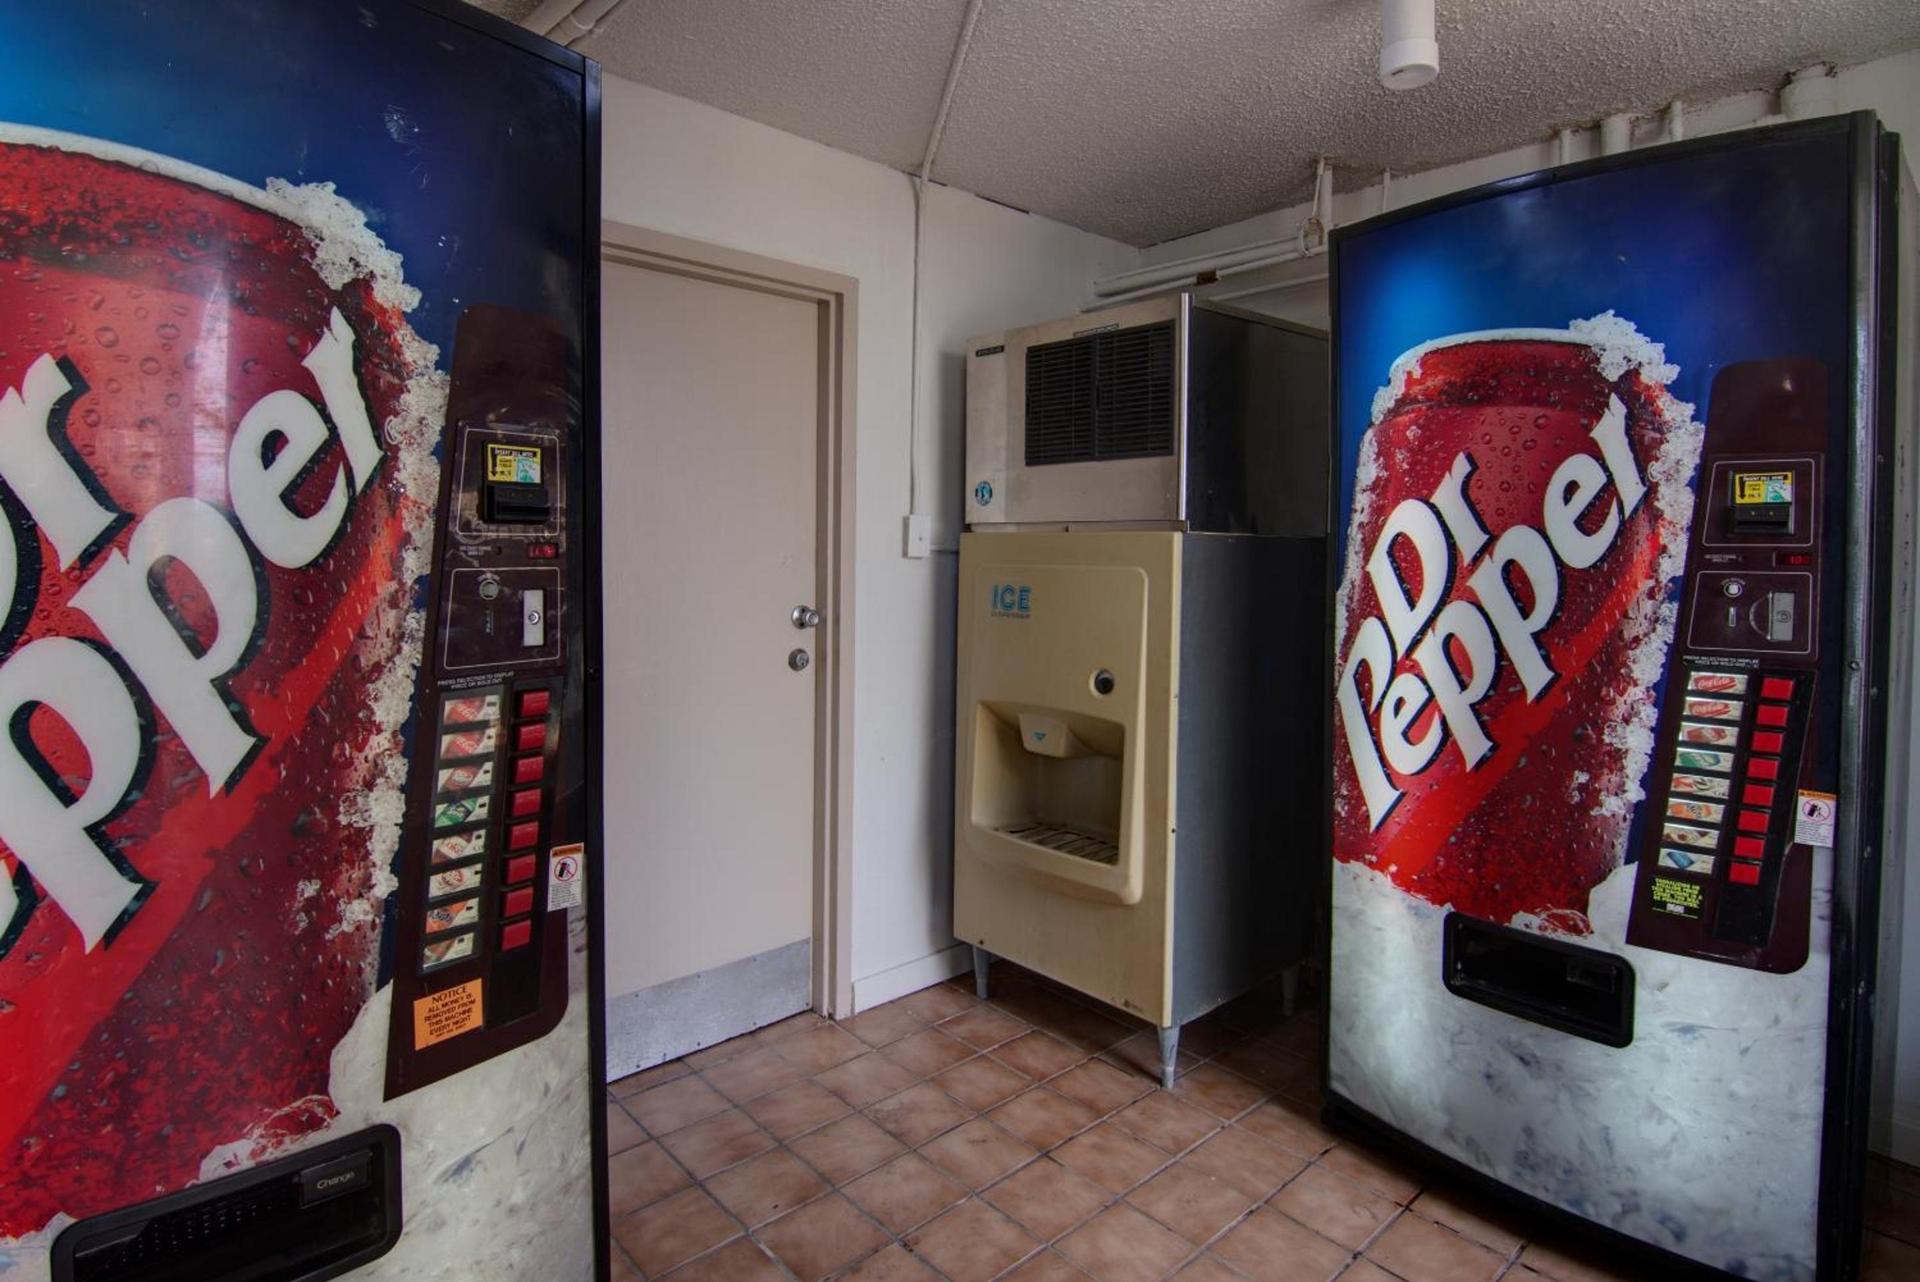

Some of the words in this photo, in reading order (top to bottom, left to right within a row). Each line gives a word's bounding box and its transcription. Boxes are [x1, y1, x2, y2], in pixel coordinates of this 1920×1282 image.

[1366, 452, 1492, 660] Dr
[992, 584, 1031, 612] ICE
[1336, 393, 1648, 834] Pepper
[0, 306, 388, 954] pper
[428, 1005, 440, 1013] ALL
[441, 996, 465, 1008] MONEY
[431, 985, 466, 1004] NOTICE
[424, 1007, 456, 1023] REMOVED
[457, 998, 476, 1010] FROM
[429, 1018, 443, 1027] THIS
[444, 1007, 473, 1022] MACHINE
[429, 1023, 450, 1036] EVERY
[452, 1014, 471, 1026] NIGHT
